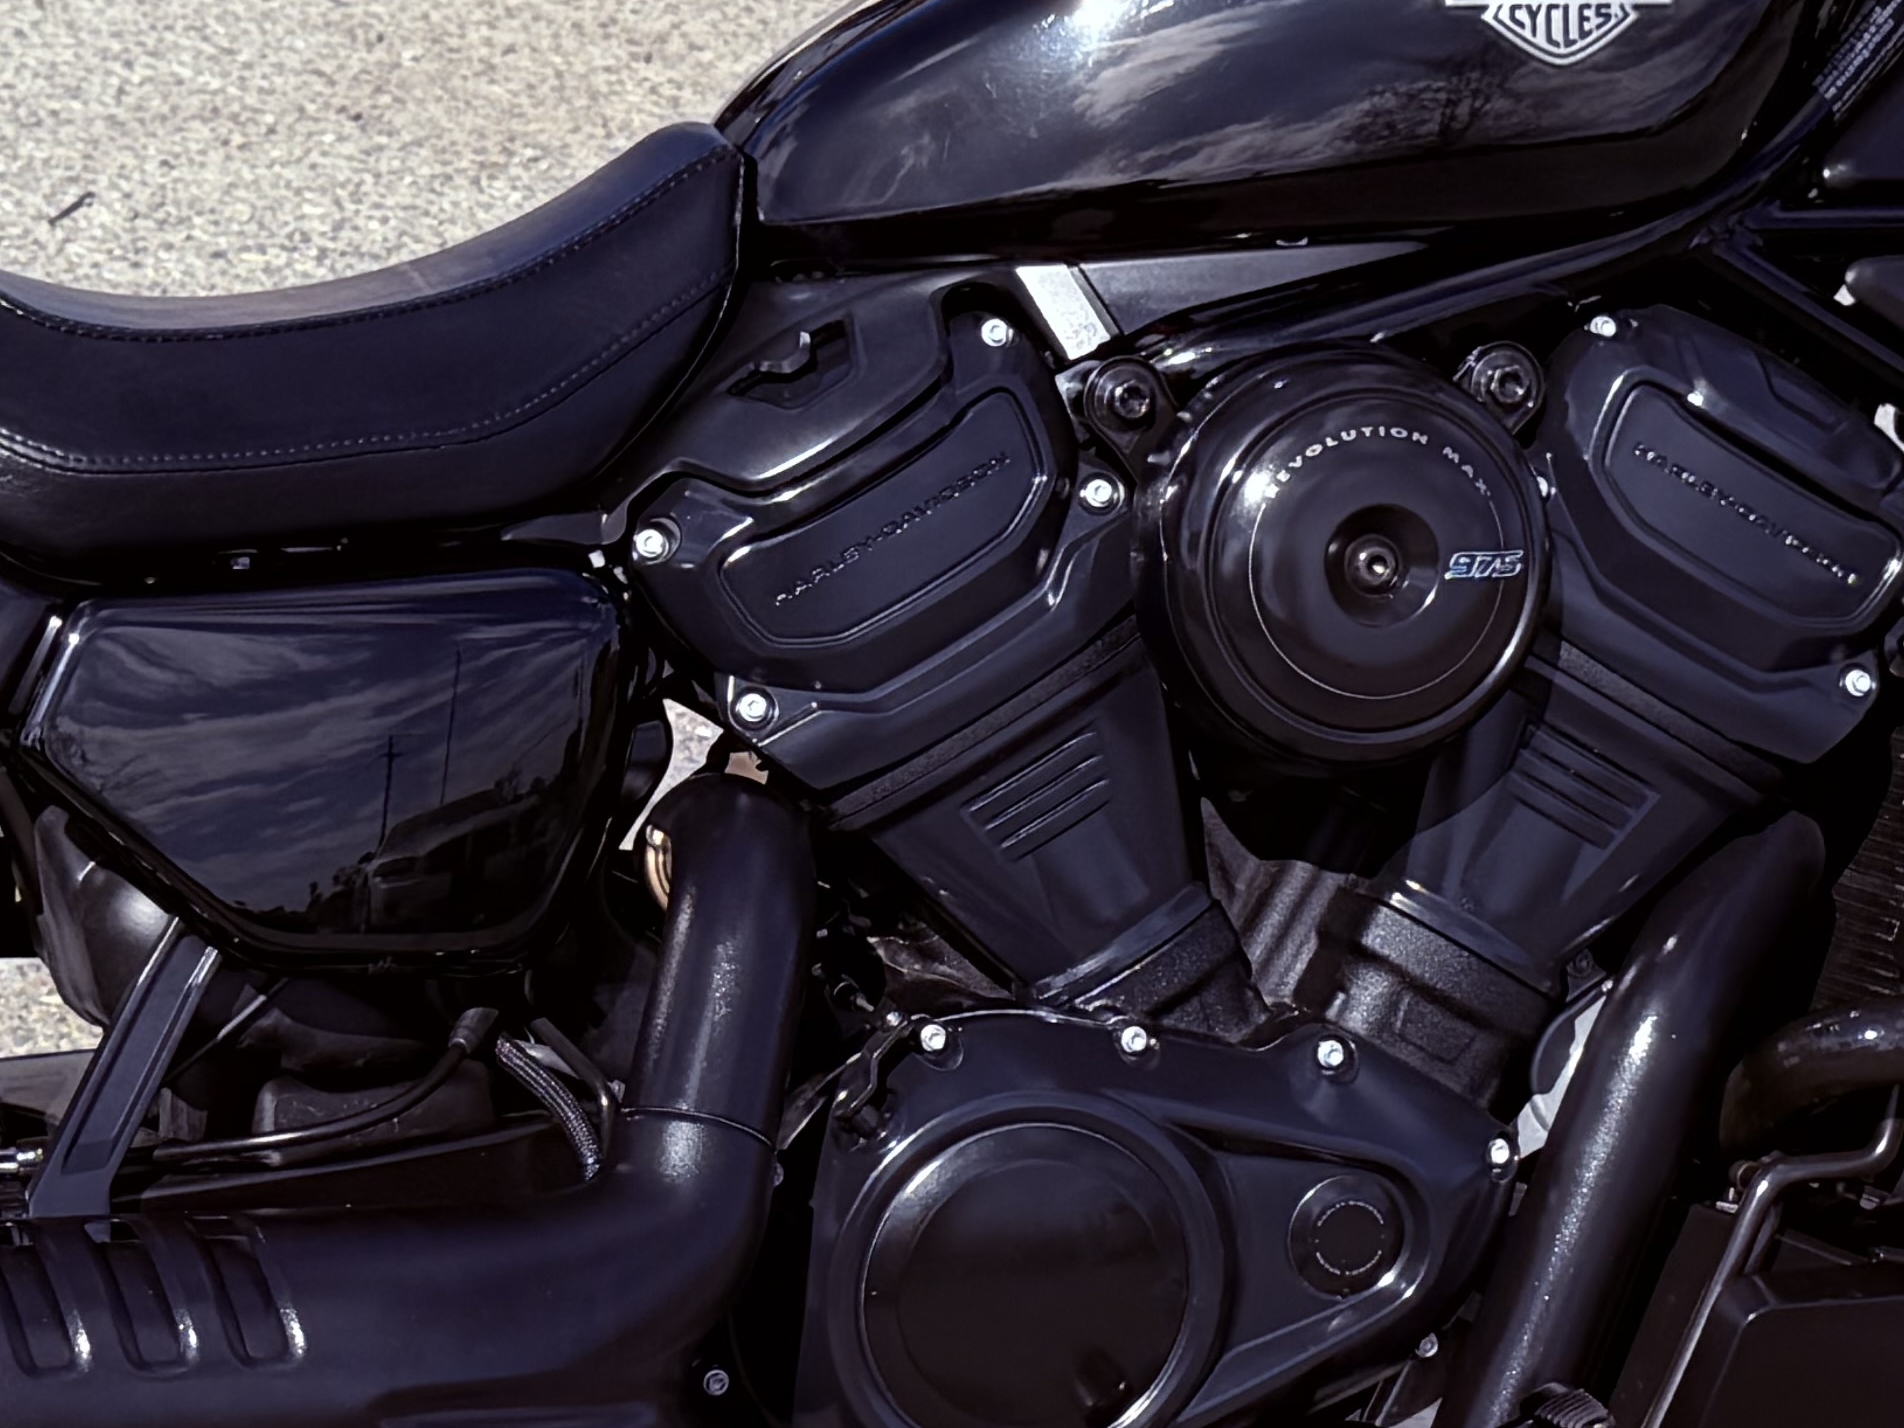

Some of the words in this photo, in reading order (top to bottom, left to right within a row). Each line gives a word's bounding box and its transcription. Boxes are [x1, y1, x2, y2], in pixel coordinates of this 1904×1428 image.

[1509, 3, 1612, 49] CYCLES
[1265, 425, 1429, 499] REVOLUTION
[1445, 551, 1524, 579] 975
